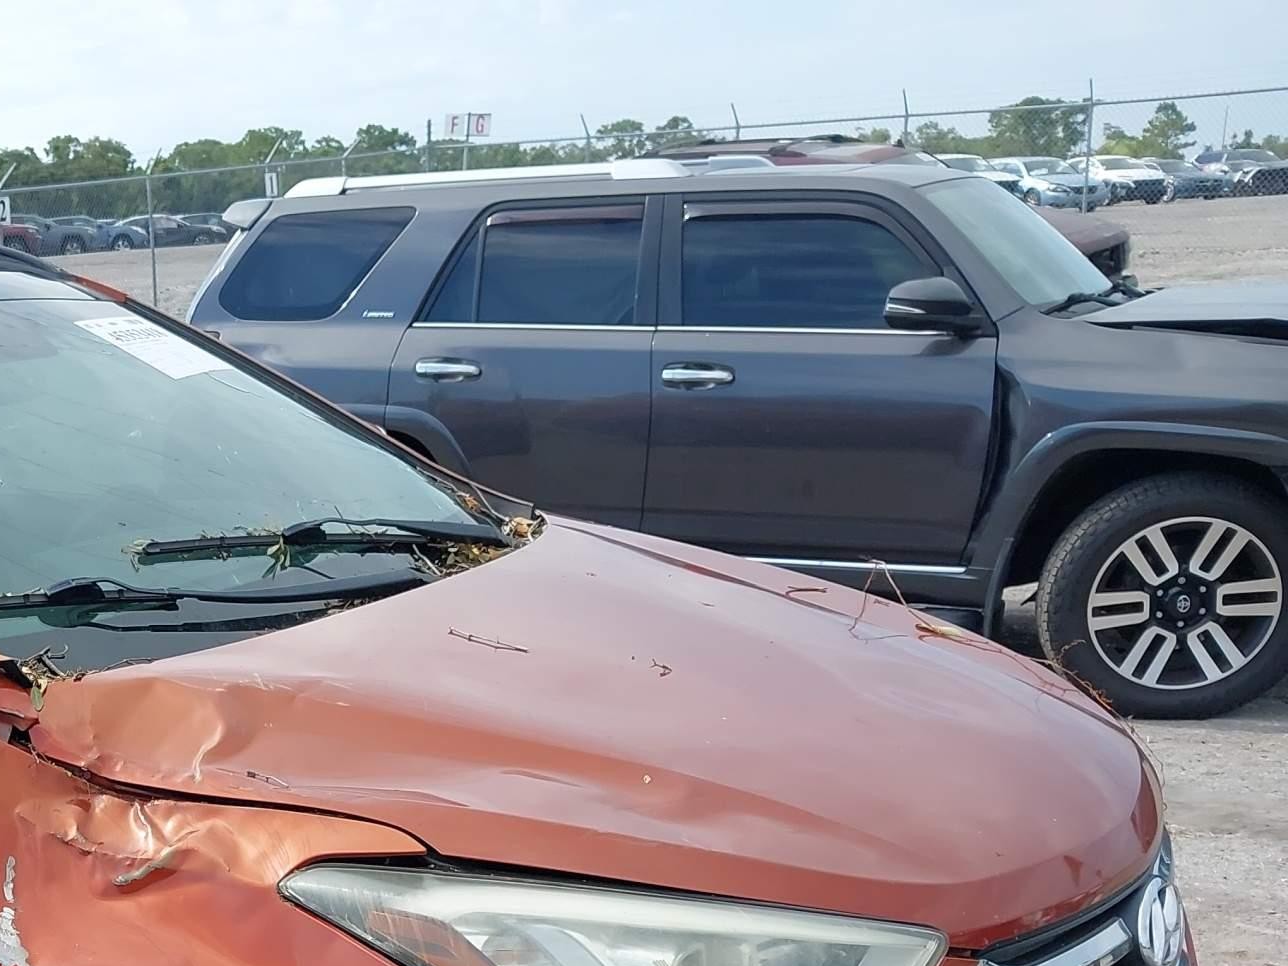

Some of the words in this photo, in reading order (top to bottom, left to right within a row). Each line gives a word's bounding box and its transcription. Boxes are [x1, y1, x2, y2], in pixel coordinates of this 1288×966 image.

[451, 115, 459, 134] F
[475, 114, 485, 134] G
[0, 199, 7, 222] 2
